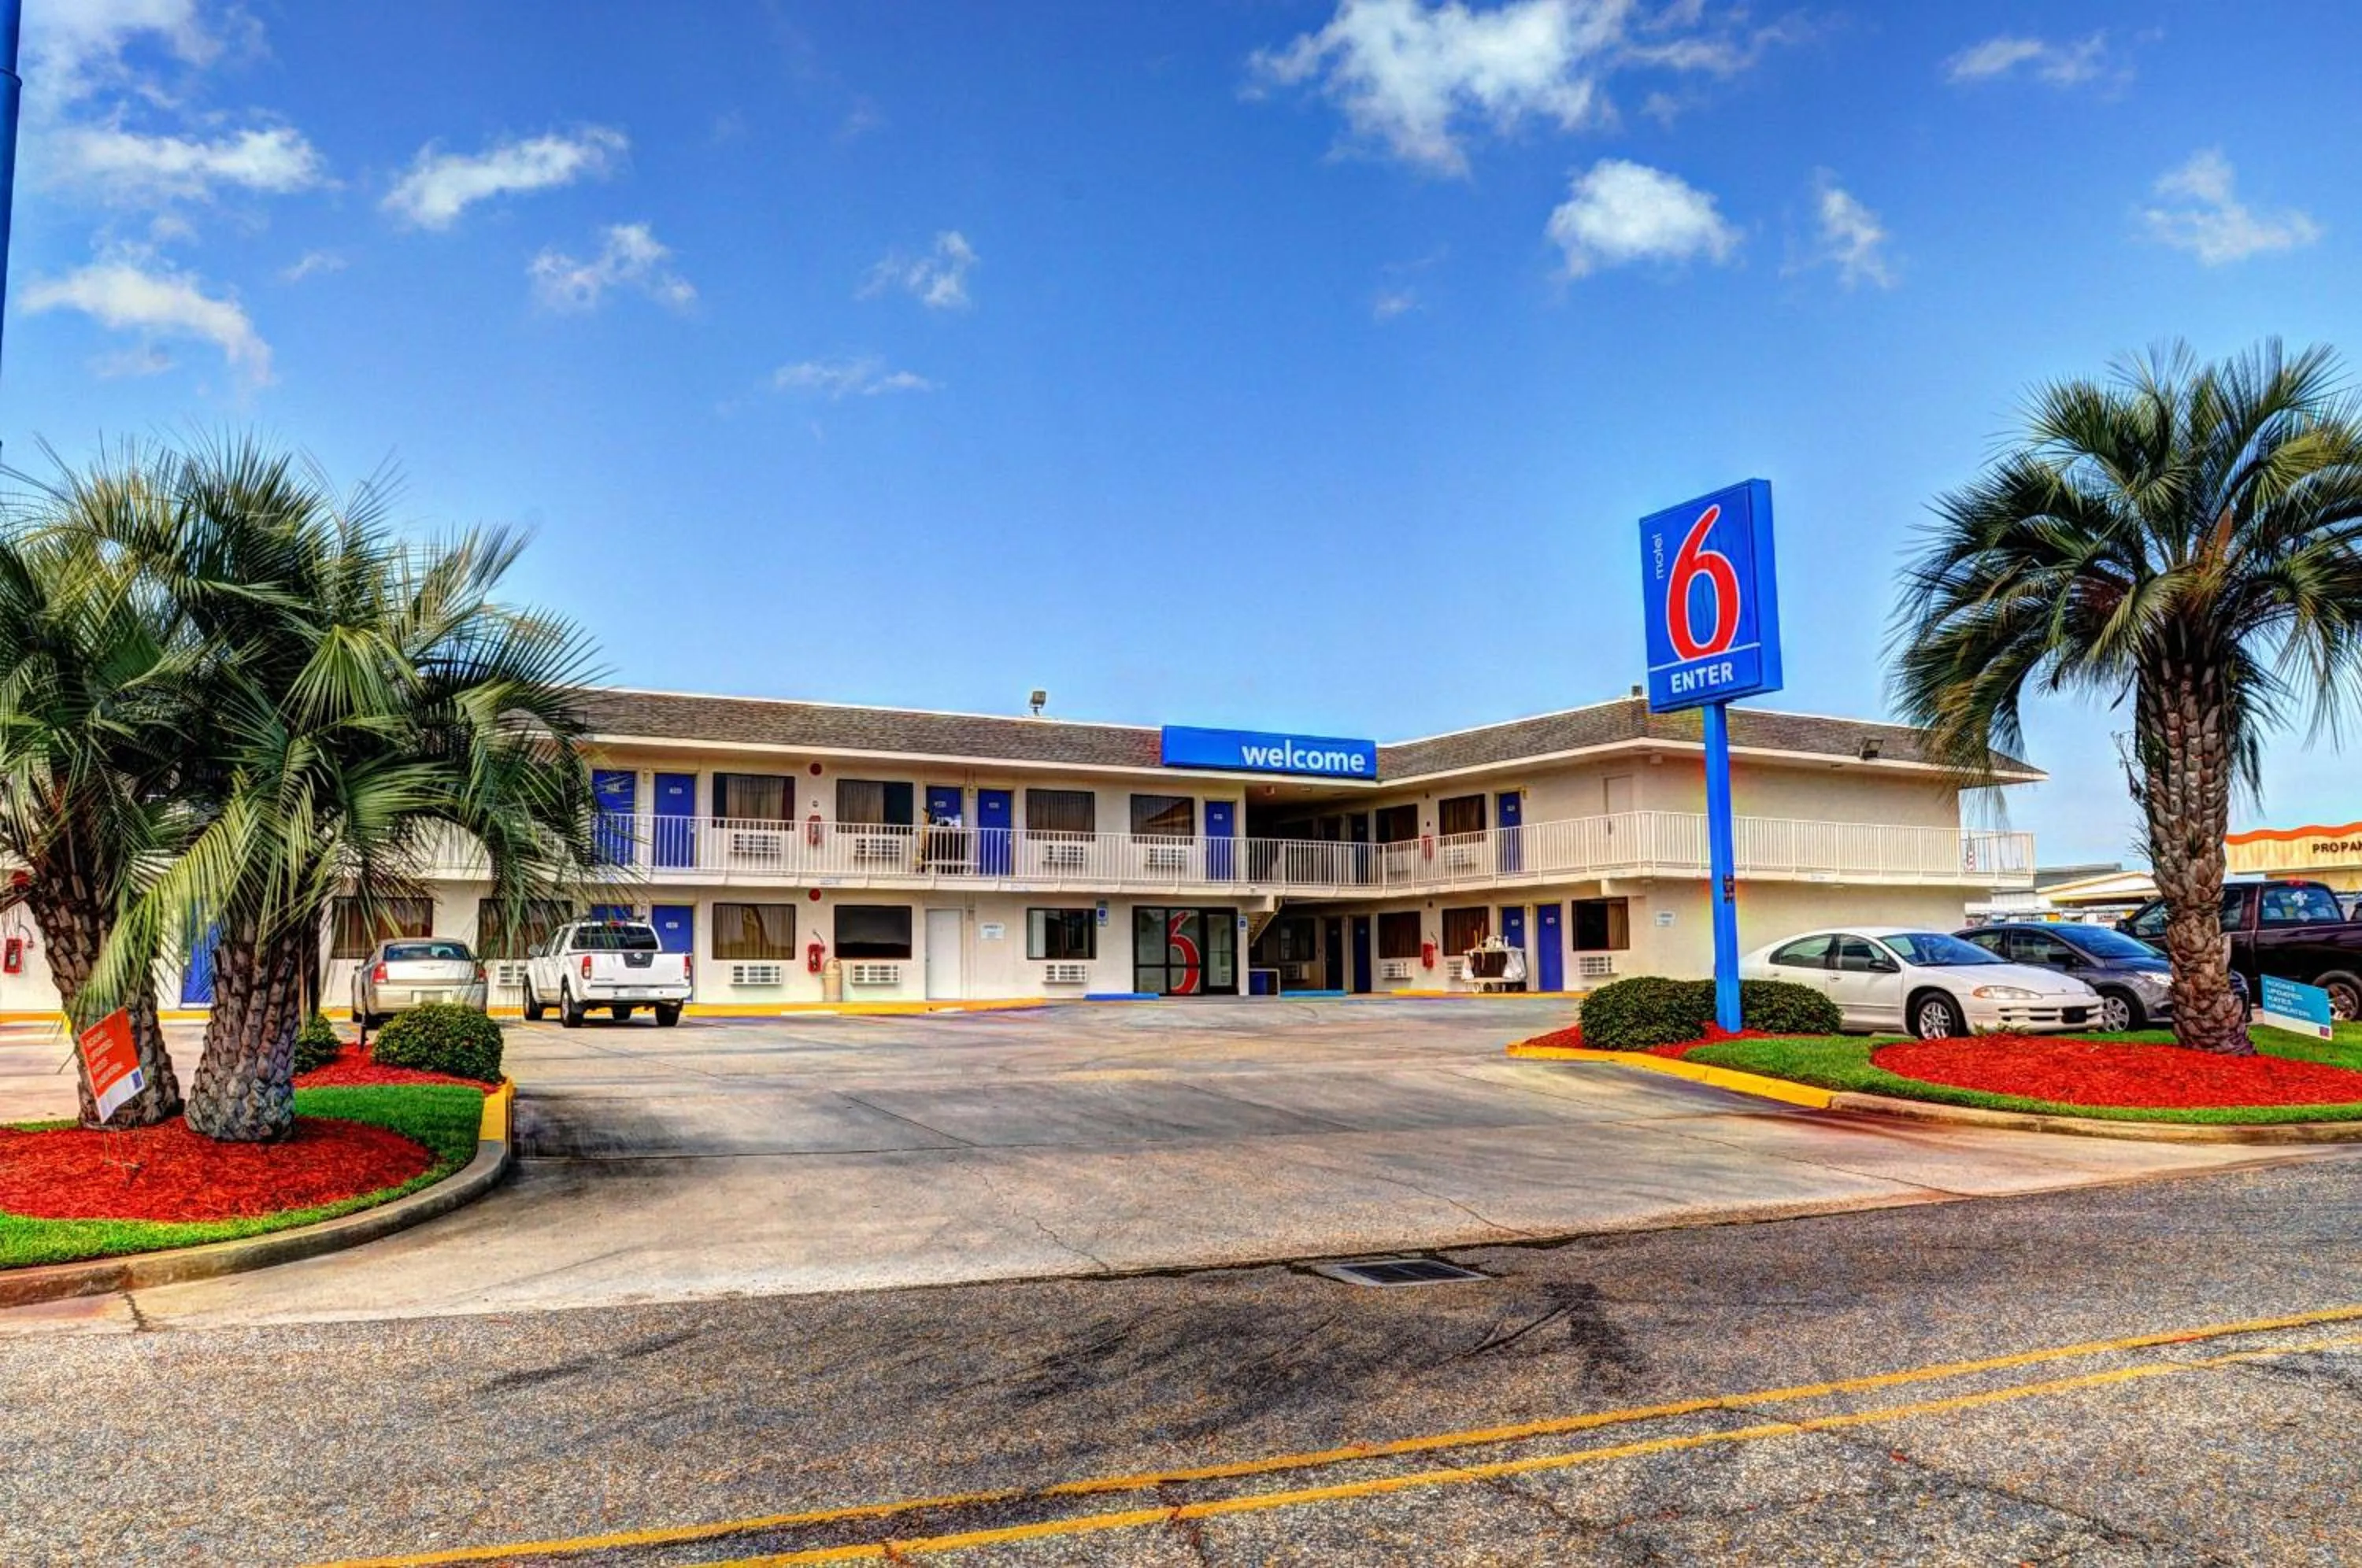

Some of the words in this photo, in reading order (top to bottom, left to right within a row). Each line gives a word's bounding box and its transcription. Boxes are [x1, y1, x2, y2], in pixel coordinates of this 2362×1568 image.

[1653, 533, 1664, 579] motel
[1666, 504, 1740, 660] 6
[1671, 663, 1734, 693] ENTER
[1242, 739, 1366, 772] welcome
